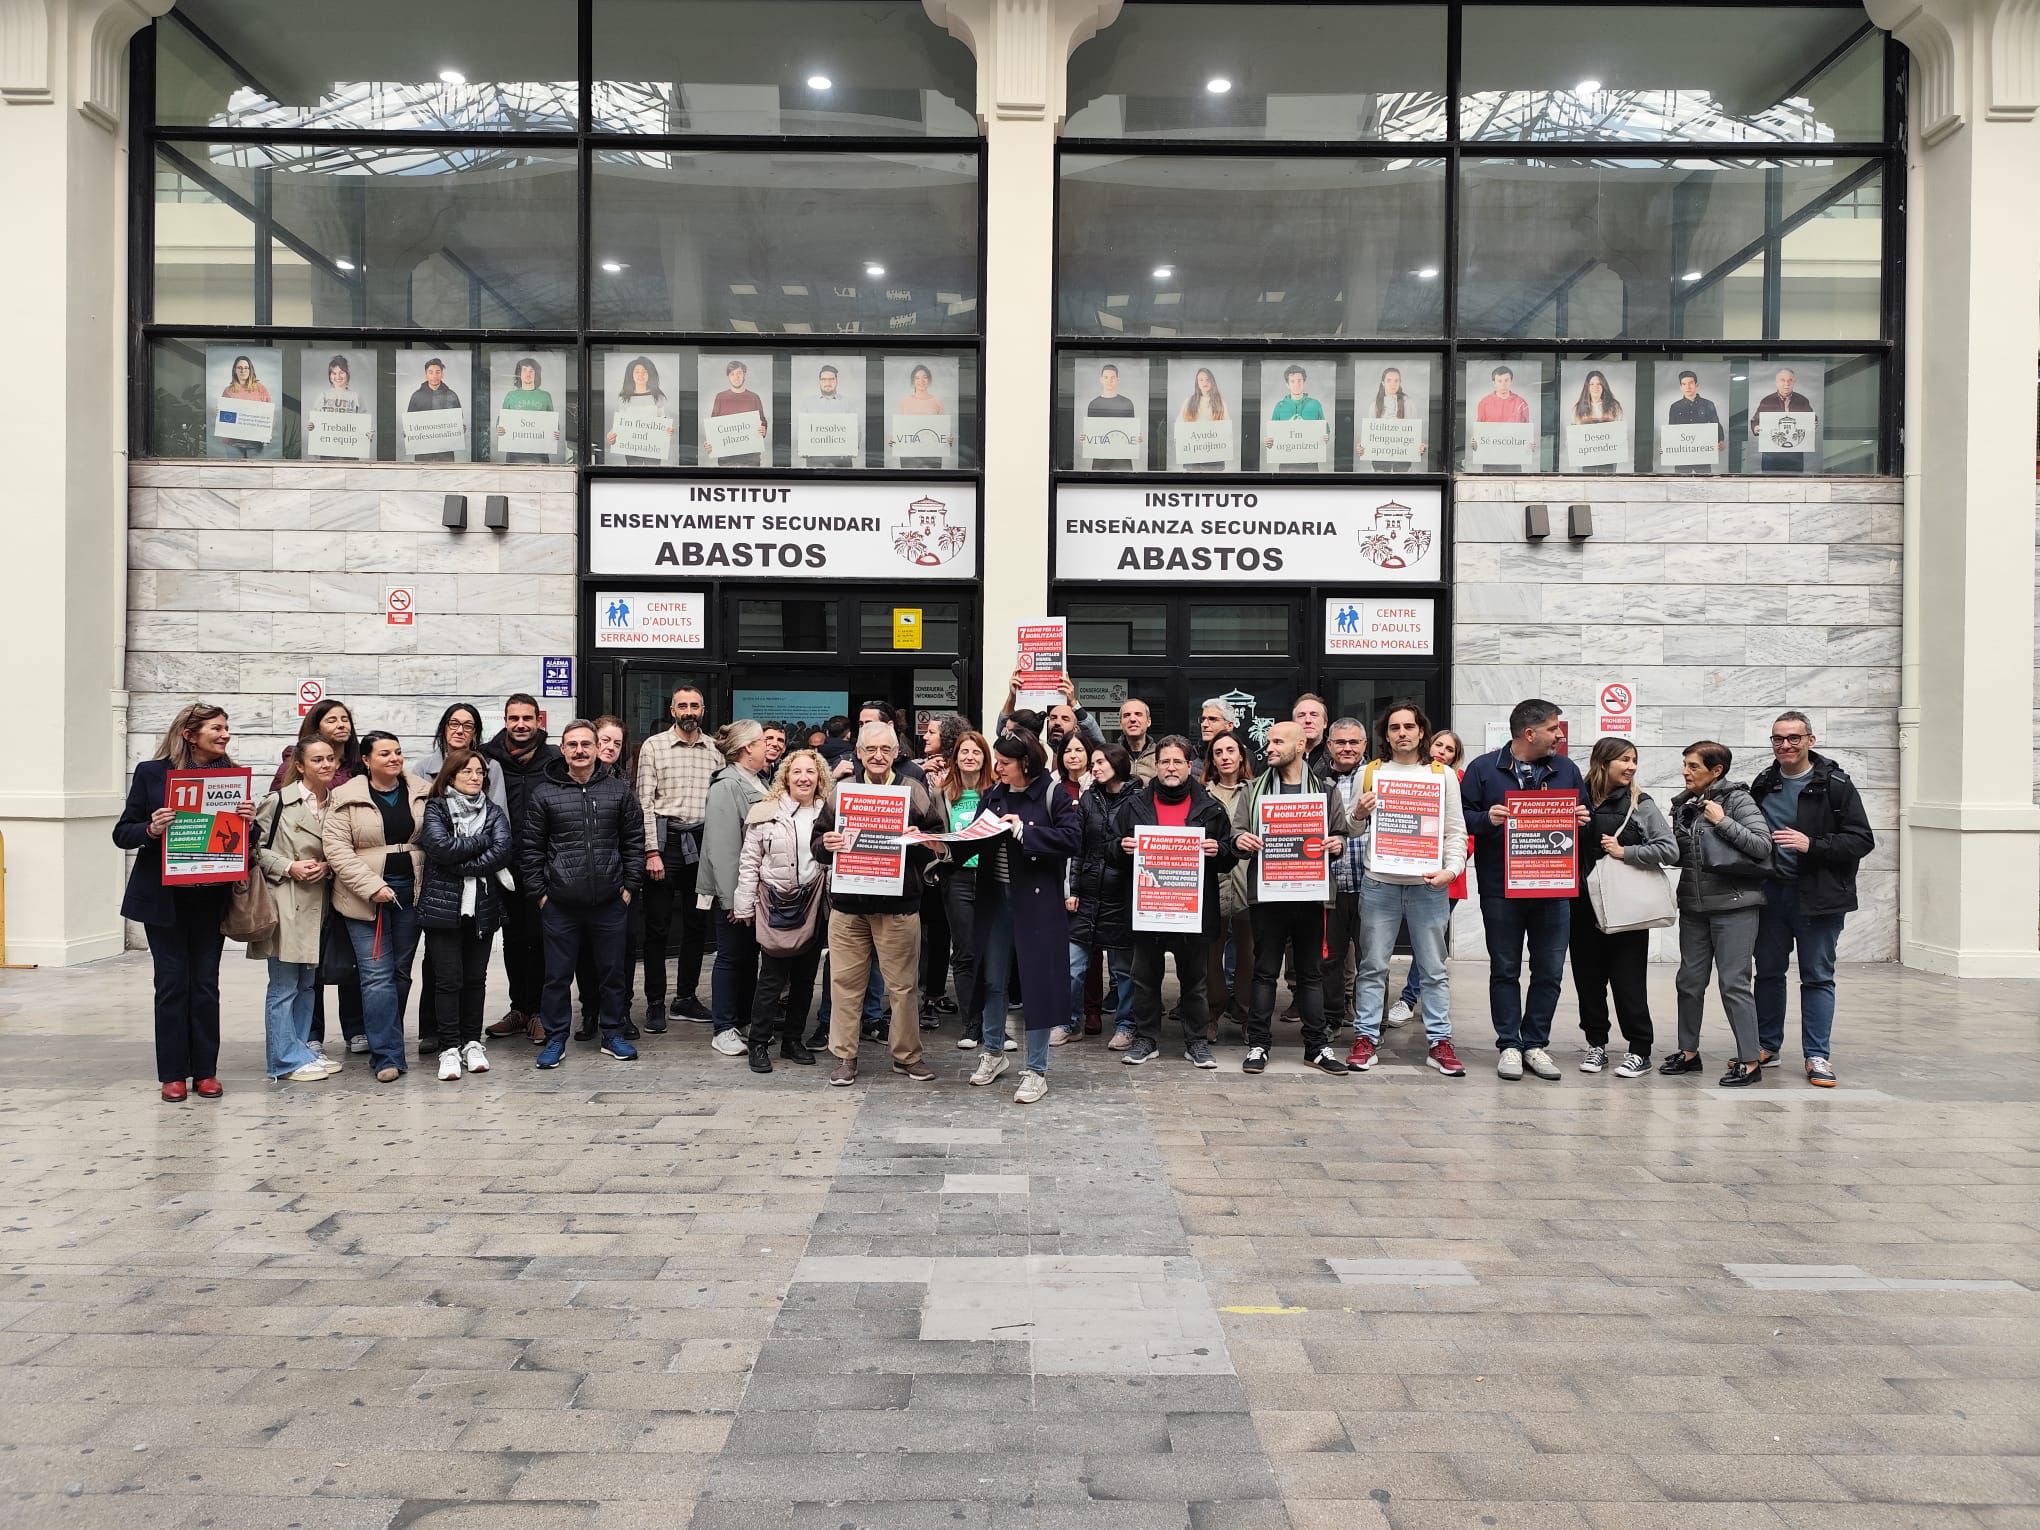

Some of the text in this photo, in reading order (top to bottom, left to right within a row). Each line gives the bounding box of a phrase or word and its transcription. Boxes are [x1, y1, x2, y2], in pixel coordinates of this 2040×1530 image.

[321, 422, 357, 432] Treballe
[414, 423, 458, 431] demonstrate
[520, 418, 536, 428] Soc
[620, 417, 666, 431] I'm flexible
[717, 422, 751, 433] Cumplo
[816, 423, 847, 433] resolve
[1370, 422, 1400, 432] Utilitze
[334, 436, 358, 446] equip
[407, 430, 462, 442] professionalism
[512, 431, 545, 440] puntual
[631, 432, 648, 440] and
[722, 435, 750, 447] plazos
[810, 435, 846, 444] conflicts
[1191, 430, 1218, 441] Ayudo
[1370, 433, 1415, 446] llenguatge
[1492, 436, 1527, 446] escoltar
[1584, 433, 1610, 441] Deseo
[1680, 432, 1696, 444] Soy
[619, 440, 661, 452] adaptable
[1183, 442, 1191, 451] al
[1276, 440, 1319, 452] organized
[1578, 443, 1618, 455] aprender
[1665, 444, 1715, 453] multitareas
[1371, 447, 1408, 457] apropiat
[690, 487, 792, 503] INSTITUT
[1145, 492, 1258, 508] INSTITUTO
[600, 513, 881, 532] ENSENYAMENT SECUNDARI
[1066, 516, 1337, 536] ENSEÑANZA SECUNDARIA
[655, 541, 828, 568] ABASTOS
[1117, 546, 1284, 572] ABASTOS
[647, 602, 688, 613] CENTRE
[1376, 608, 1417, 619] CENTRE
[642, 616, 692, 627] D'ADULTS
[1020, 628, 1026, 638] 7
[1371, 622, 1422, 633] D'ADULTS
[600, 633, 701, 644] SERRANO MORALES
[1329, 638, 1430, 649] SERRANO MORALES
[1380, 782, 1390, 793] 7
[1389, 788, 1440, 797] MOBILITZACIÓ
[175, 786, 198, 807] 11
[207, 790, 242, 800] VAGA
[843, 797, 853, 811] 7
[853, 797, 876, 805] RAONS
[851, 804, 903, 814] MOBILITZACIÓ
[1511, 801, 1521, 814] 7
[1264, 805, 1275, 819] 7
[1141, 837, 1151, 850] 7
[1150, 843, 1200, 851] MOBILITZACIÓ
